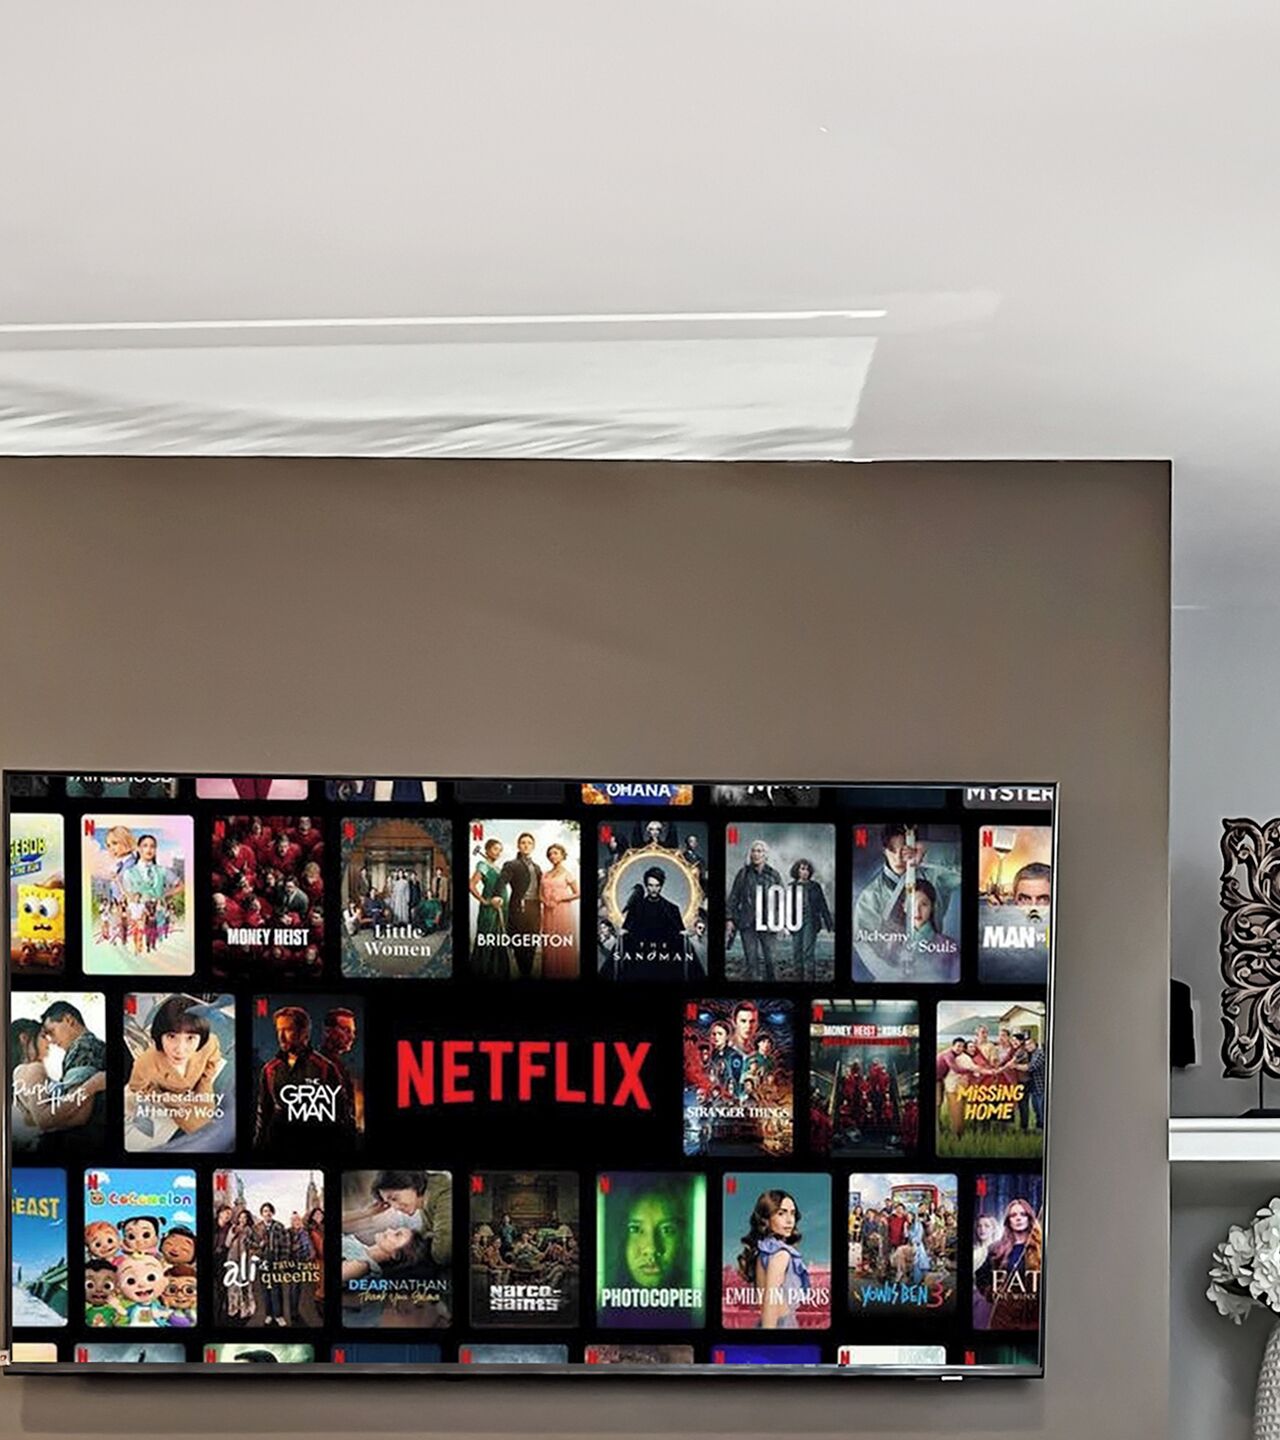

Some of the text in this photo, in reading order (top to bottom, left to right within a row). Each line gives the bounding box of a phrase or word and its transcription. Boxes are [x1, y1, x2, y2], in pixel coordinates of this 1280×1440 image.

[755, 884, 803, 933] LOU
[227, 928, 309, 945] MONEY HEIST
[374, 924, 423, 939] Little
[477, 933, 573, 947] BRIDGERTON
[982, 926, 1035, 949] MAN
[365, 942, 431, 957] Women
[918, 939, 957, 953] Souls
[397, 1040, 652, 1110] NETFLIX
[136, 1090, 224, 1106] Extraordinary
[279, 1084, 343, 1106] GRAY
[194, 1106, 225, 1118] Woo
[288, 1102, 336, 1122] MAN
[686, 1105, 791, 1119] STRANGER THINGS
[964, 1102, 1014, 1120] HOME
[223, 1251, 260, 1288] ali
[261, 1271, 321, 1289] queens
[601, 1287, 703, 1308] PHOTOCOPIER
[724, 1287, 830, 1308] EMILY IN PARIS
